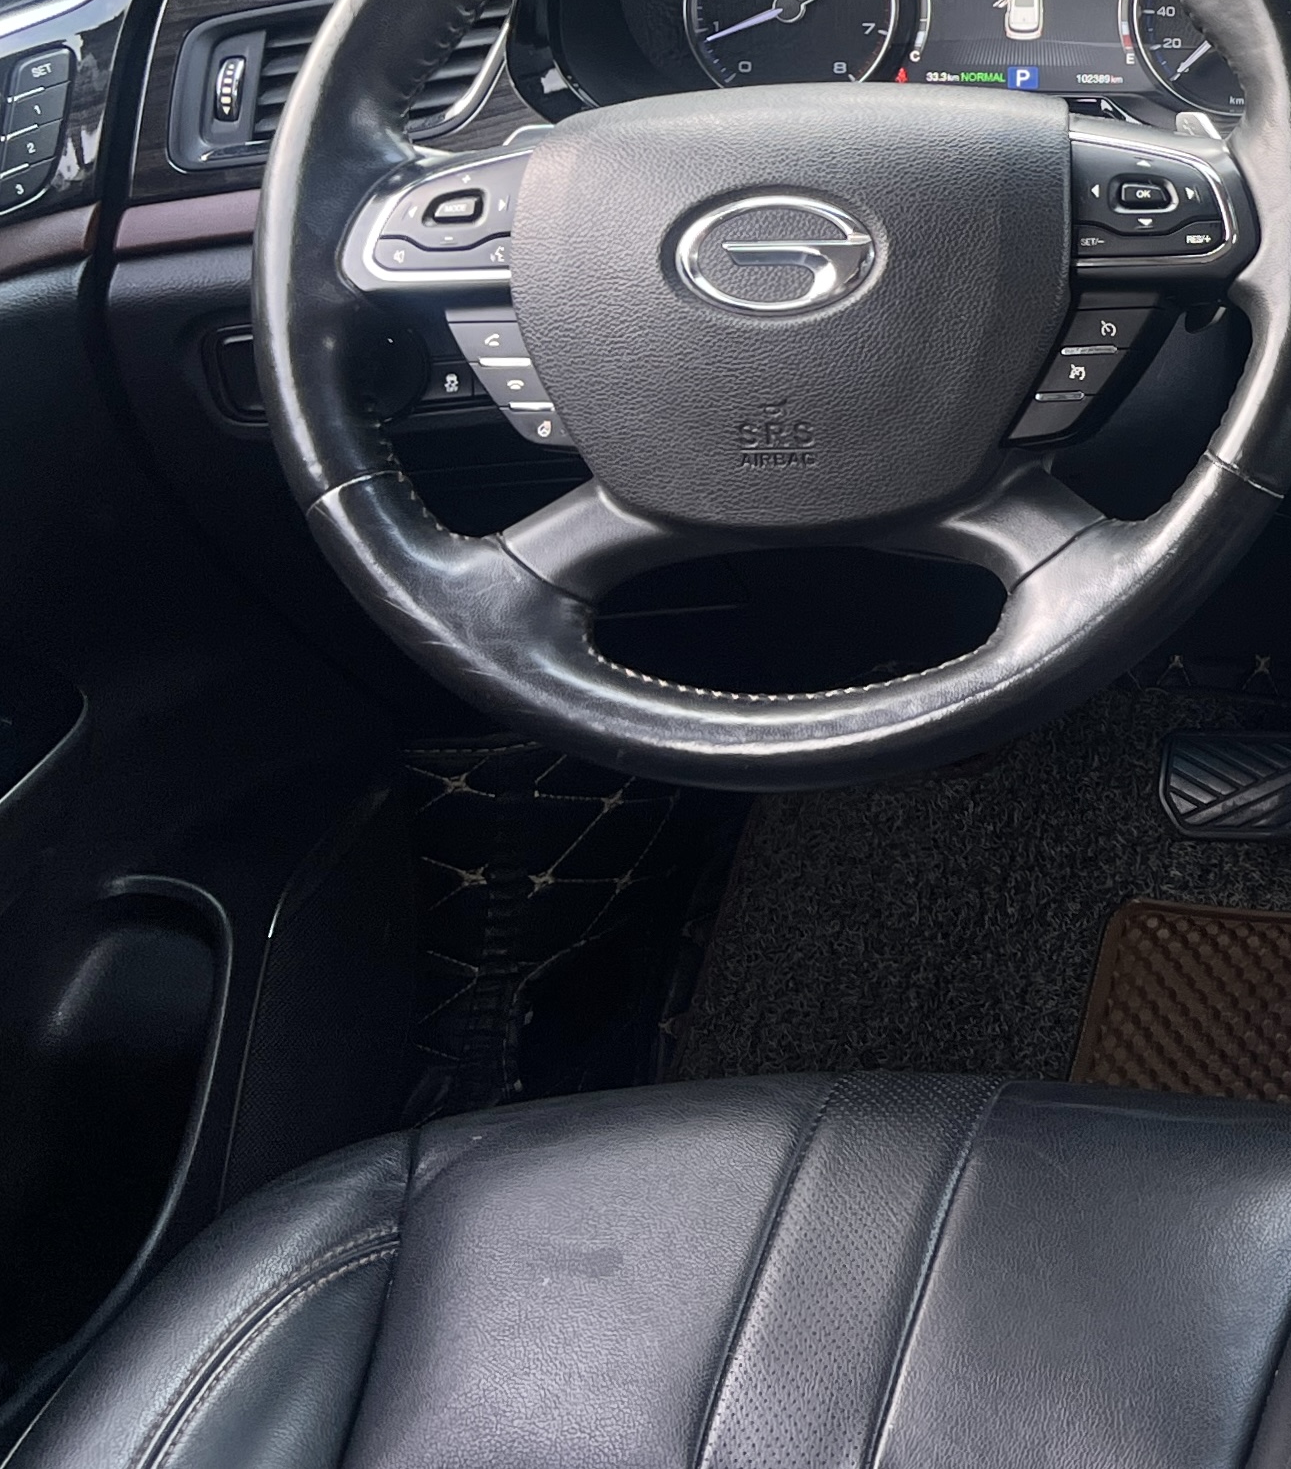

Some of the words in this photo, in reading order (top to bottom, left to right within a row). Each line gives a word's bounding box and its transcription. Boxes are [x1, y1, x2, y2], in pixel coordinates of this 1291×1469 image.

[1156, 6, 1176, 17] 40
[862, 23, 876, 35] 7
[1163, 38, 1182, 49] 20
[909, 51, 921, 62] C
[1126, 53, 1135, 65] E
[31, 63, 52, 78] SET
[738, 61, 752, 73] 0
[833, 62, 847, 74] 8
[961, 72, 1006, 83] NORMAL
[1016, 70, 1031, 87] P
[34, 104, 41, 115] 1
[26, 142, 36, 154] 2
[15, 184, 24, 195] 3
[1135, 189, 1151, 199] OK
[739, 421, 815, 448] SRS
